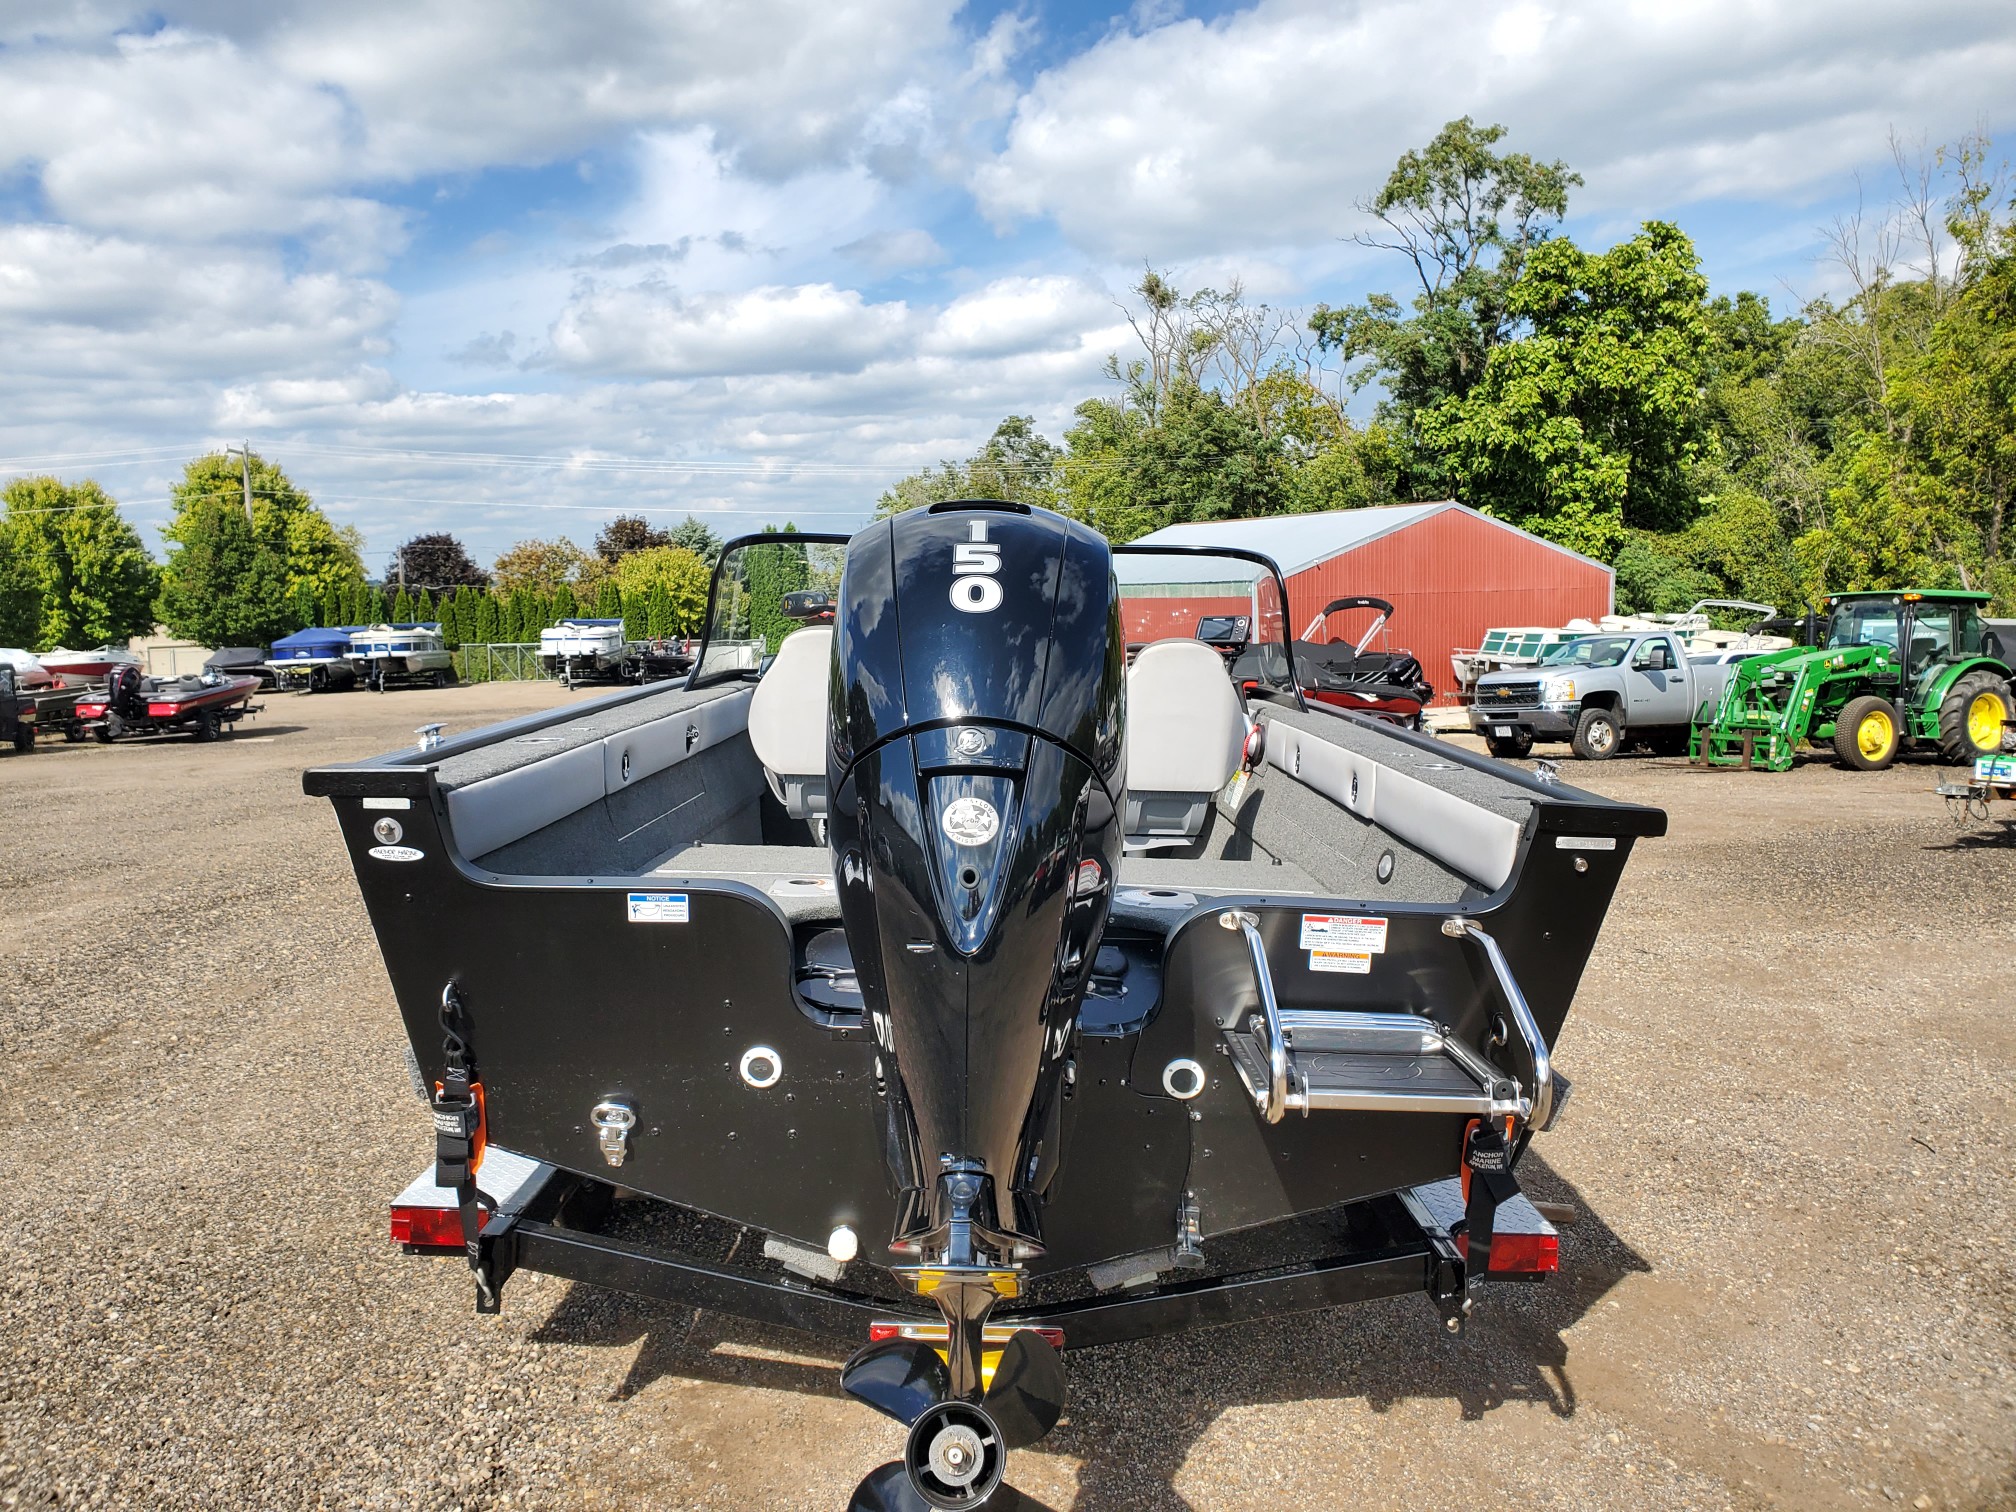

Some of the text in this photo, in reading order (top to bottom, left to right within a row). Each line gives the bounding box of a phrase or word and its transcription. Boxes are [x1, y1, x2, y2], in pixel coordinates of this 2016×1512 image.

[949, 520, 1004, 614] 150
[1333, 917, 1362, 925] DANGER
[1327, 951, 1360, 959] WARNING
[1472, 1149, 1504, 1158] ANCHOR
[1472, 1155, 1502, 1164] MARINE
